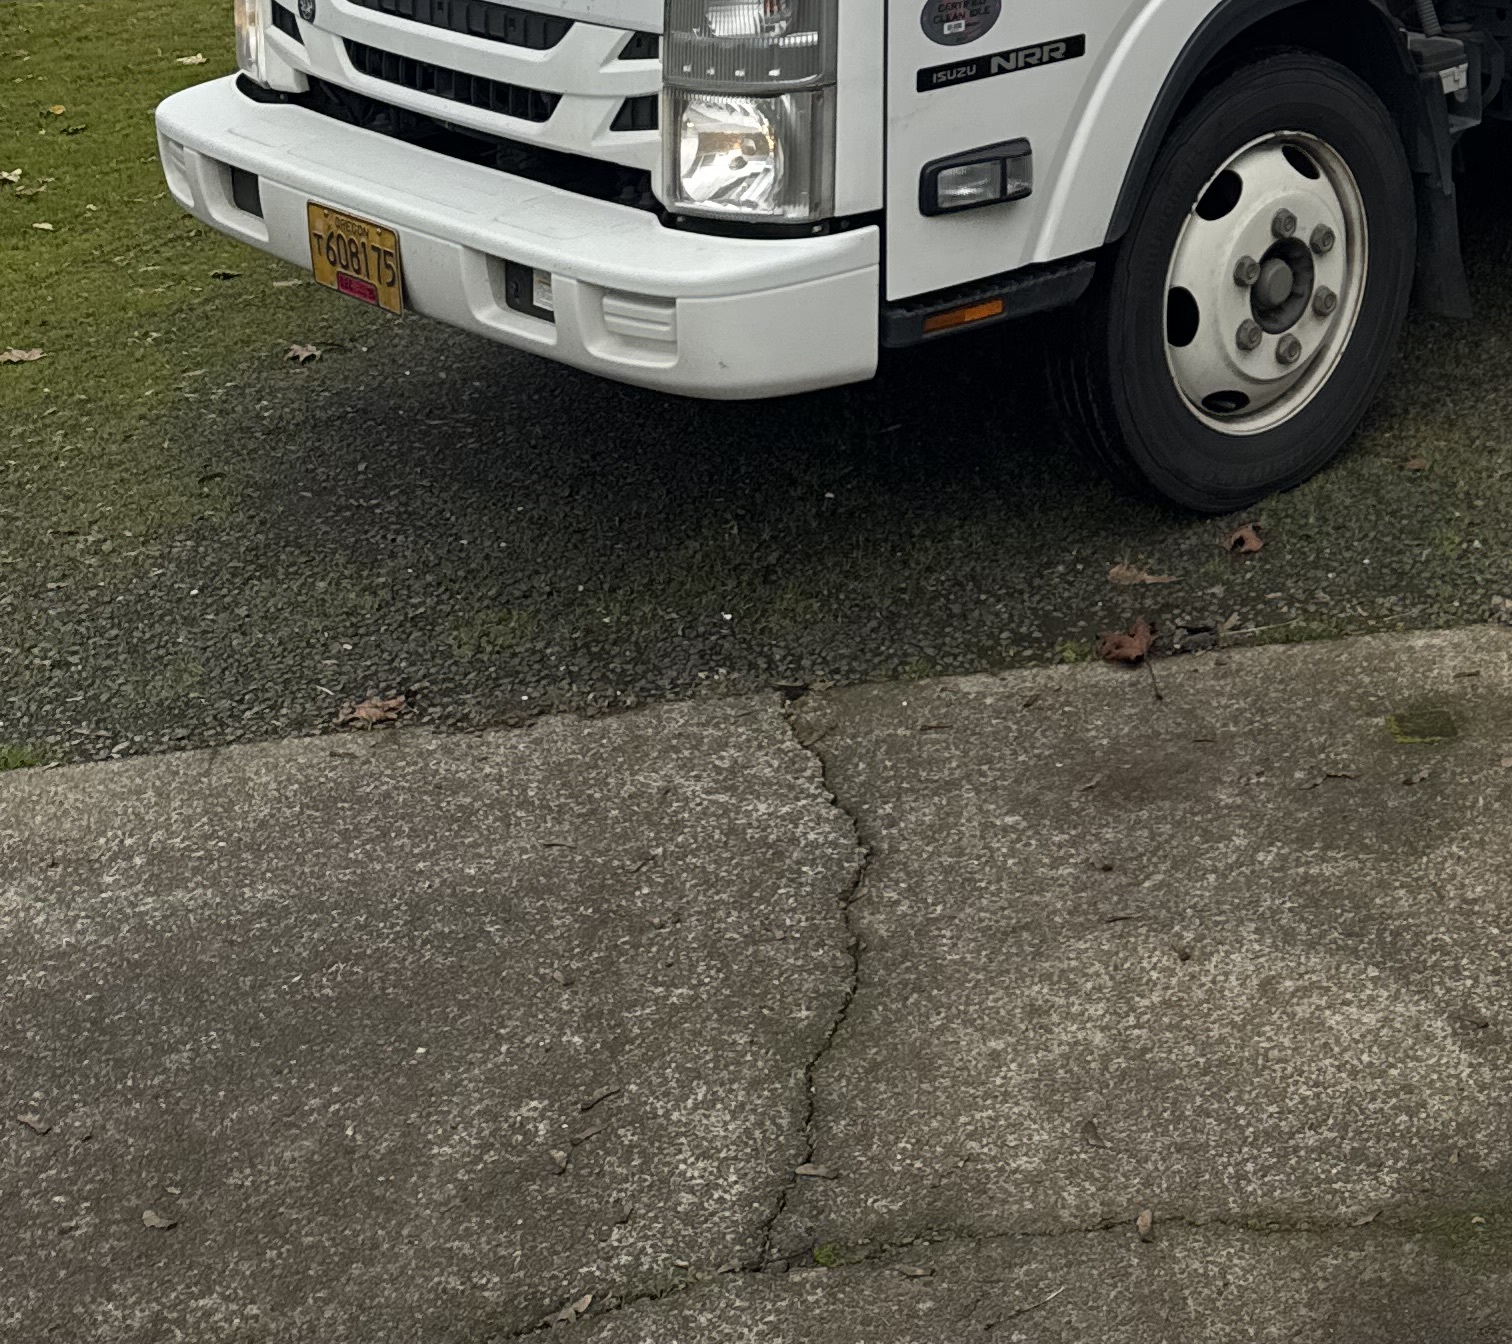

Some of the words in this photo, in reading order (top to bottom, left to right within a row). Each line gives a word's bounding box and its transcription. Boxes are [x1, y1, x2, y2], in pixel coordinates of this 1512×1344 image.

[933, 12, 966, 25] CLEAN
[969, 5, 991, 17] IDLE
[932, 63, 977, 84] ISUZU
[990, 41, 1067, 75] NRR
[334, 216, 370, 238] OREGON
